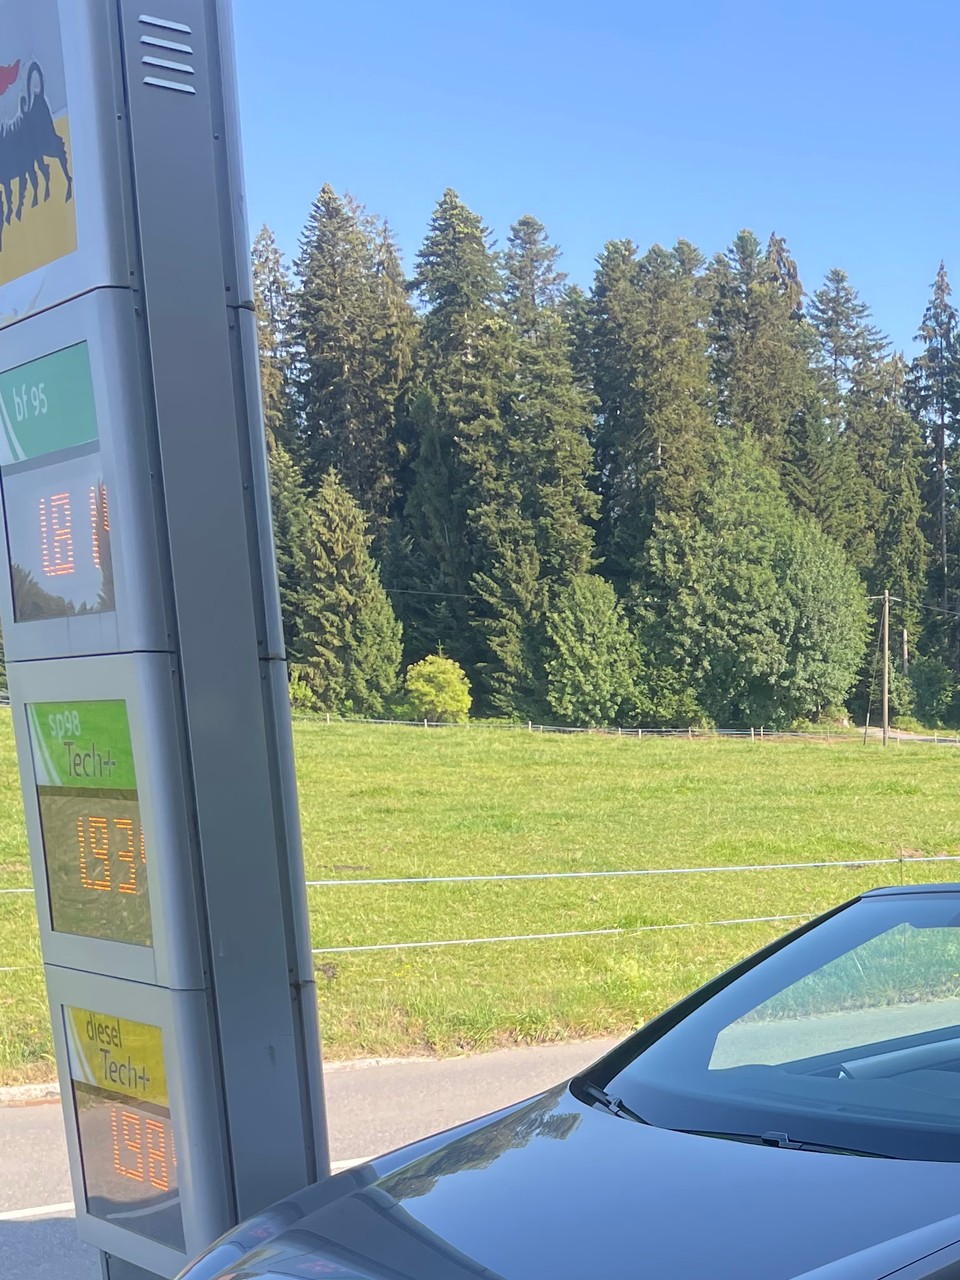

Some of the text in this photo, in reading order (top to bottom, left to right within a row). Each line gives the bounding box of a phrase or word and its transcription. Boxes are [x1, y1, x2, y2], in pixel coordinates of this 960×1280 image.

[12, 382, 48, 422] bf 95
[48, 710, 82, 743] sp98
[63, 741, 116, 778] Tech+
[86, 1013, 123, 1049] diesel
[99, 1047, 151, 1092] Tech+
